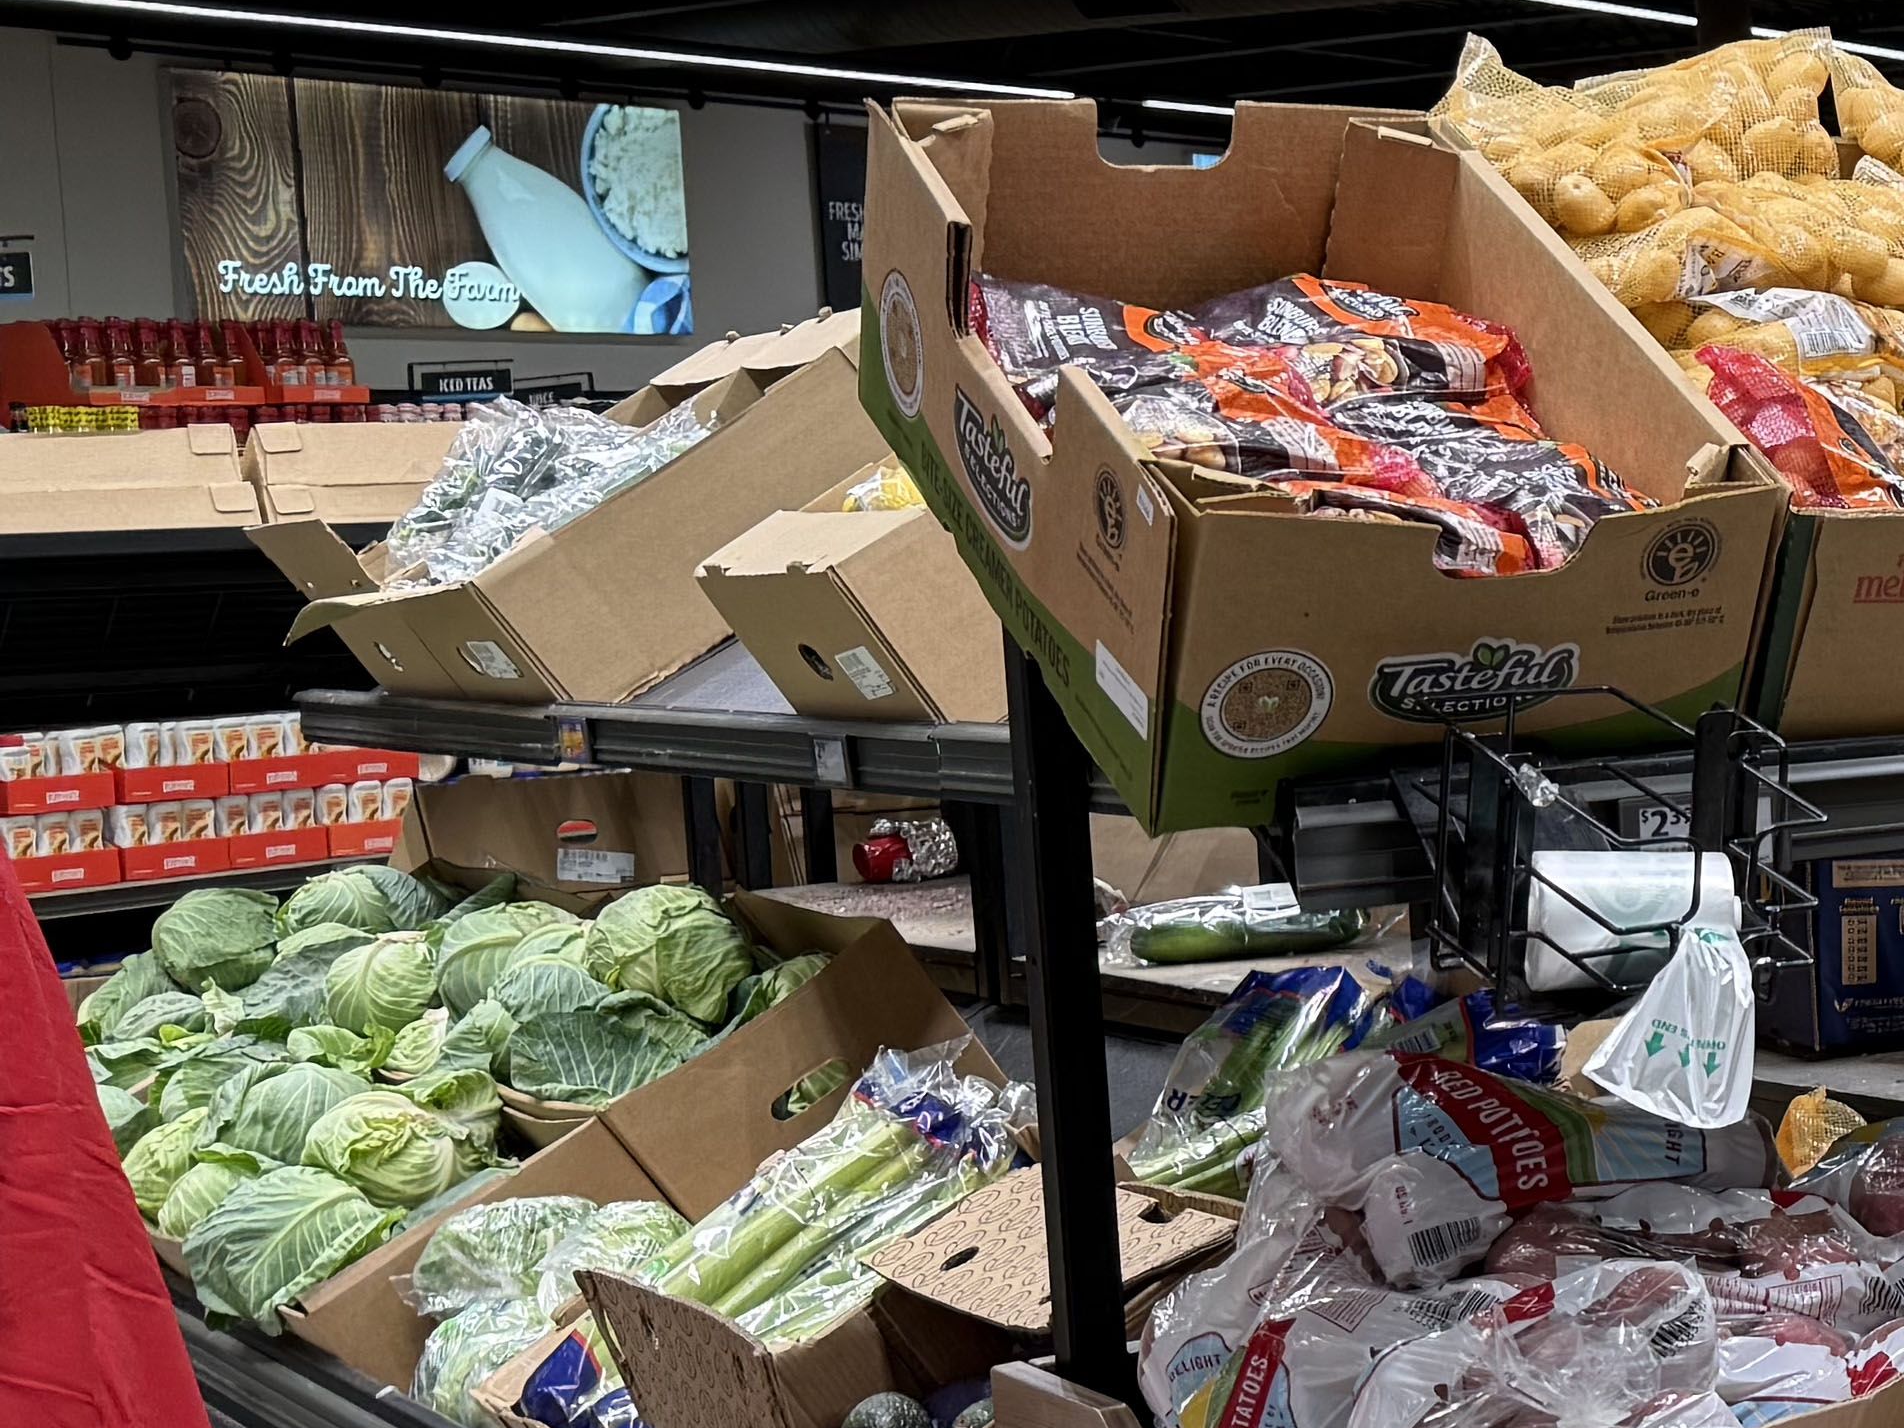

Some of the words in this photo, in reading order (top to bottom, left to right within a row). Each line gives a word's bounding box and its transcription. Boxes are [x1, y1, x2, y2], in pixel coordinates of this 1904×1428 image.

[217, 259, 304, 296] Fresh
[307, 262, 386, 298] From
[389, 265, 442, 301] The
[446, 269, 524, 303] Farm
[439, 377, 464, 393] ICED
[466, 376, 494, 392] TEAS
[956, 391, 1031, 518] Tasteful
[920, 443, 964, 534] BITE-SIZE
[965, 516, 1014, 608] CREAMER
[1012, 588, 1072, 687] POTATOES
[1644, 585, 1700, 604] Green-e
[1379, 651, 1569, 696] Tasteful
[1400, 694, 1538, 716] SLECTIO
[1433, 1070, 1474, 1110] RED
[1478, 1104, 1549, 1192] POTOES
